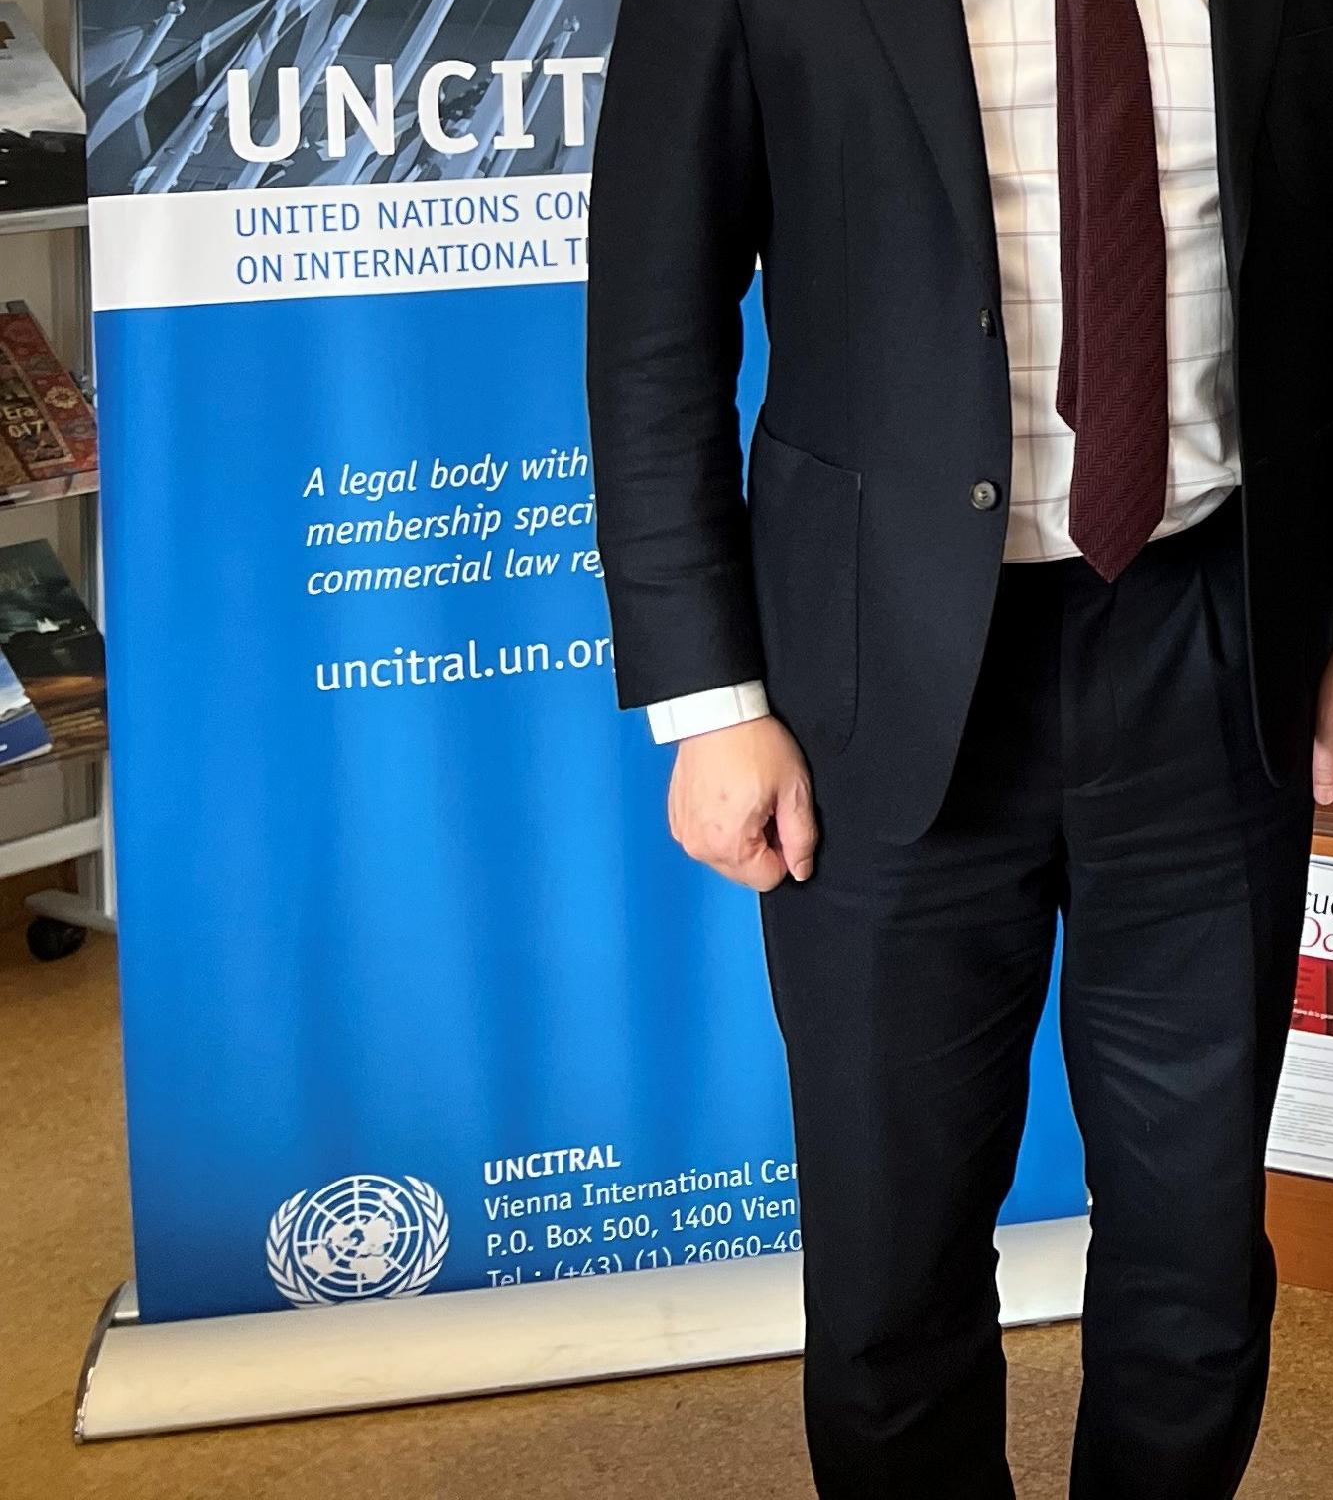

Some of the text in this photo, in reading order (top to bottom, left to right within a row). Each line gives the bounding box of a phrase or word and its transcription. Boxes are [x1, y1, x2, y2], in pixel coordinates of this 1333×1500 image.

[226, 56, 606, 163] UNCIT
[235, 203, 361, 238] UNITED
[378, 194, 520, 230] NATIONS
[236, 239, 559, 285] ON INTERNATIONAL
[303, 446, 589, 501] A legal body with
[306, 493, 596, 547] membership speci
[307, 547, 561, 596] commercial law
[484, 1144, 622, 1186] UNCITRAL
[484, 1162, 753, 1222] Vienna International
[485, 1195, 796, 1258] P.O. Box 500, 1400 Vien
